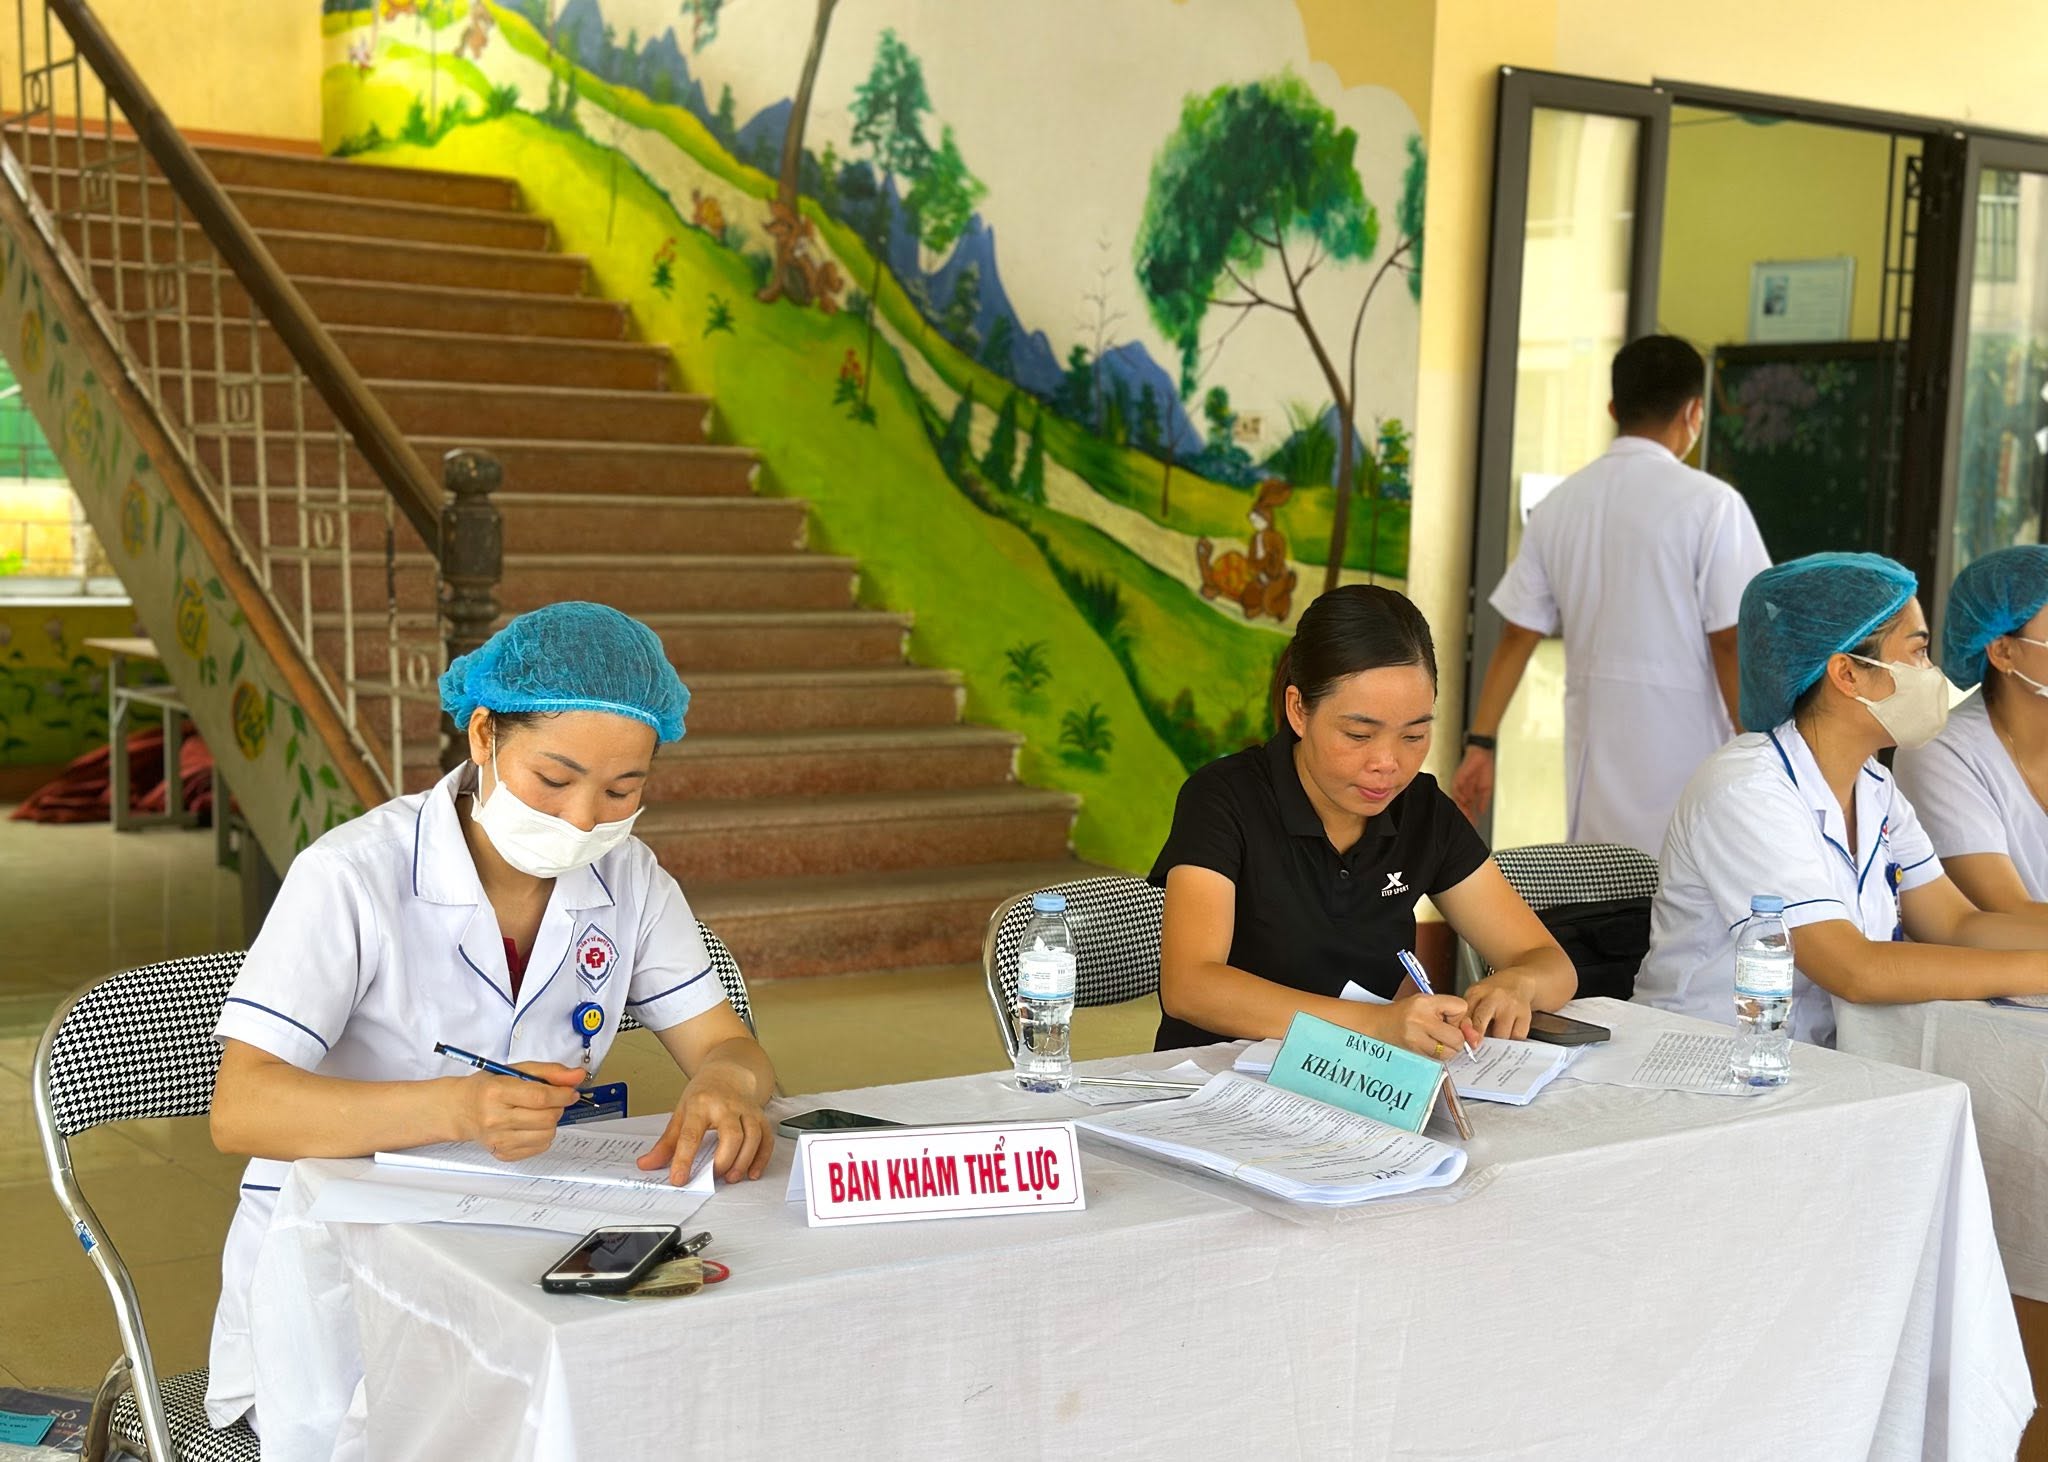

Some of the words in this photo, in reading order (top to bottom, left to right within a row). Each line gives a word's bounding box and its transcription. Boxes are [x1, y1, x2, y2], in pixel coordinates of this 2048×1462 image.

[1300, 1053, 1355, 1088] KHÁM
[1352, 1074, 1413, 1113] NGOẠI
[1386, 1050, 1392, 1062] 1
[828, 1152, 882, 1203] BÀN
[887, 1148, 960, 1199] KHÁM
[964, 1136, 1010, 1195] THỂ
[1013, 1146, 1060, 1201] LỰC
